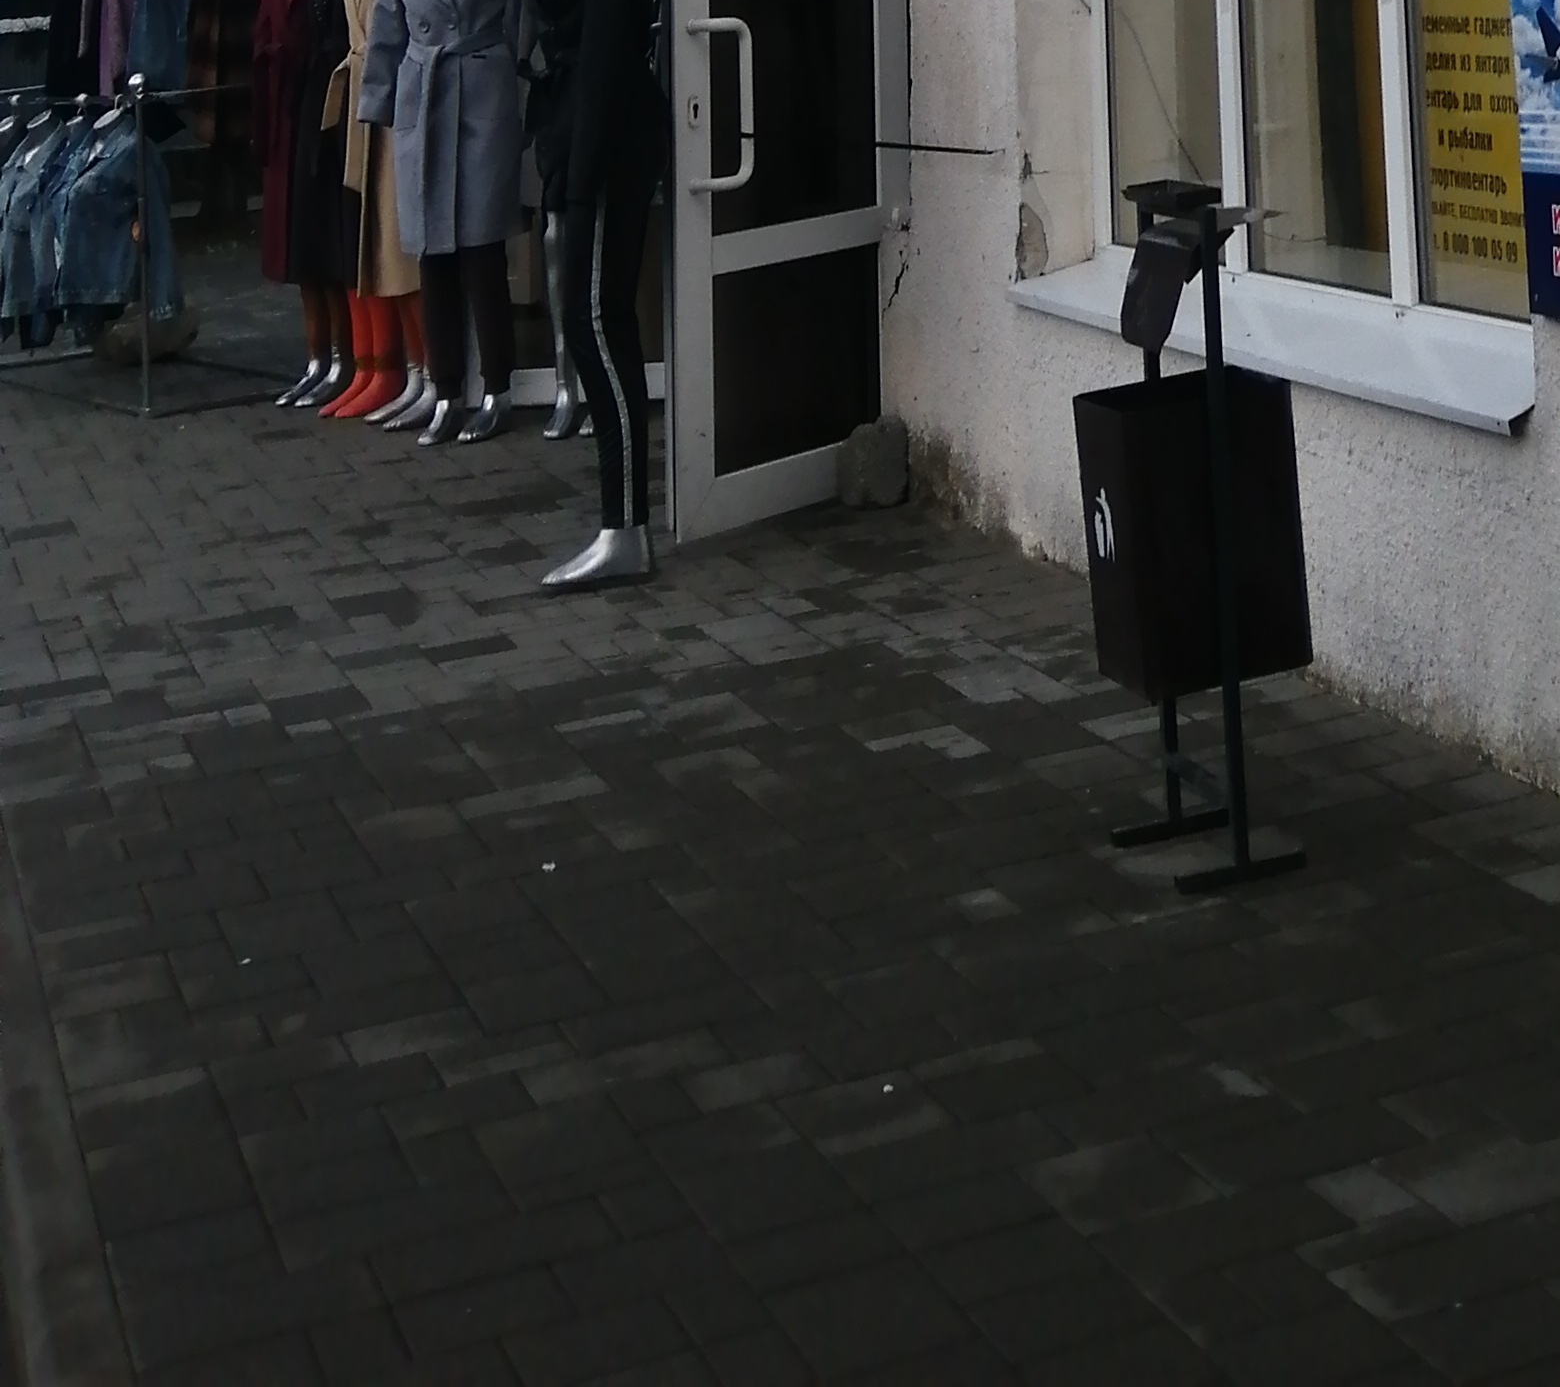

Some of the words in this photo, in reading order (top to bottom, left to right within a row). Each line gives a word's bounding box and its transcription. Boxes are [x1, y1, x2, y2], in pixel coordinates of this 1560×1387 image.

[1460, 54, 1470, 72] из
[1475, 55, 1510, 77] янтаря
[1463, 92, 1482, 113] для
[1438, 128, 1444, 146] и
[1448, 127, 1492, 151] рыбалки
